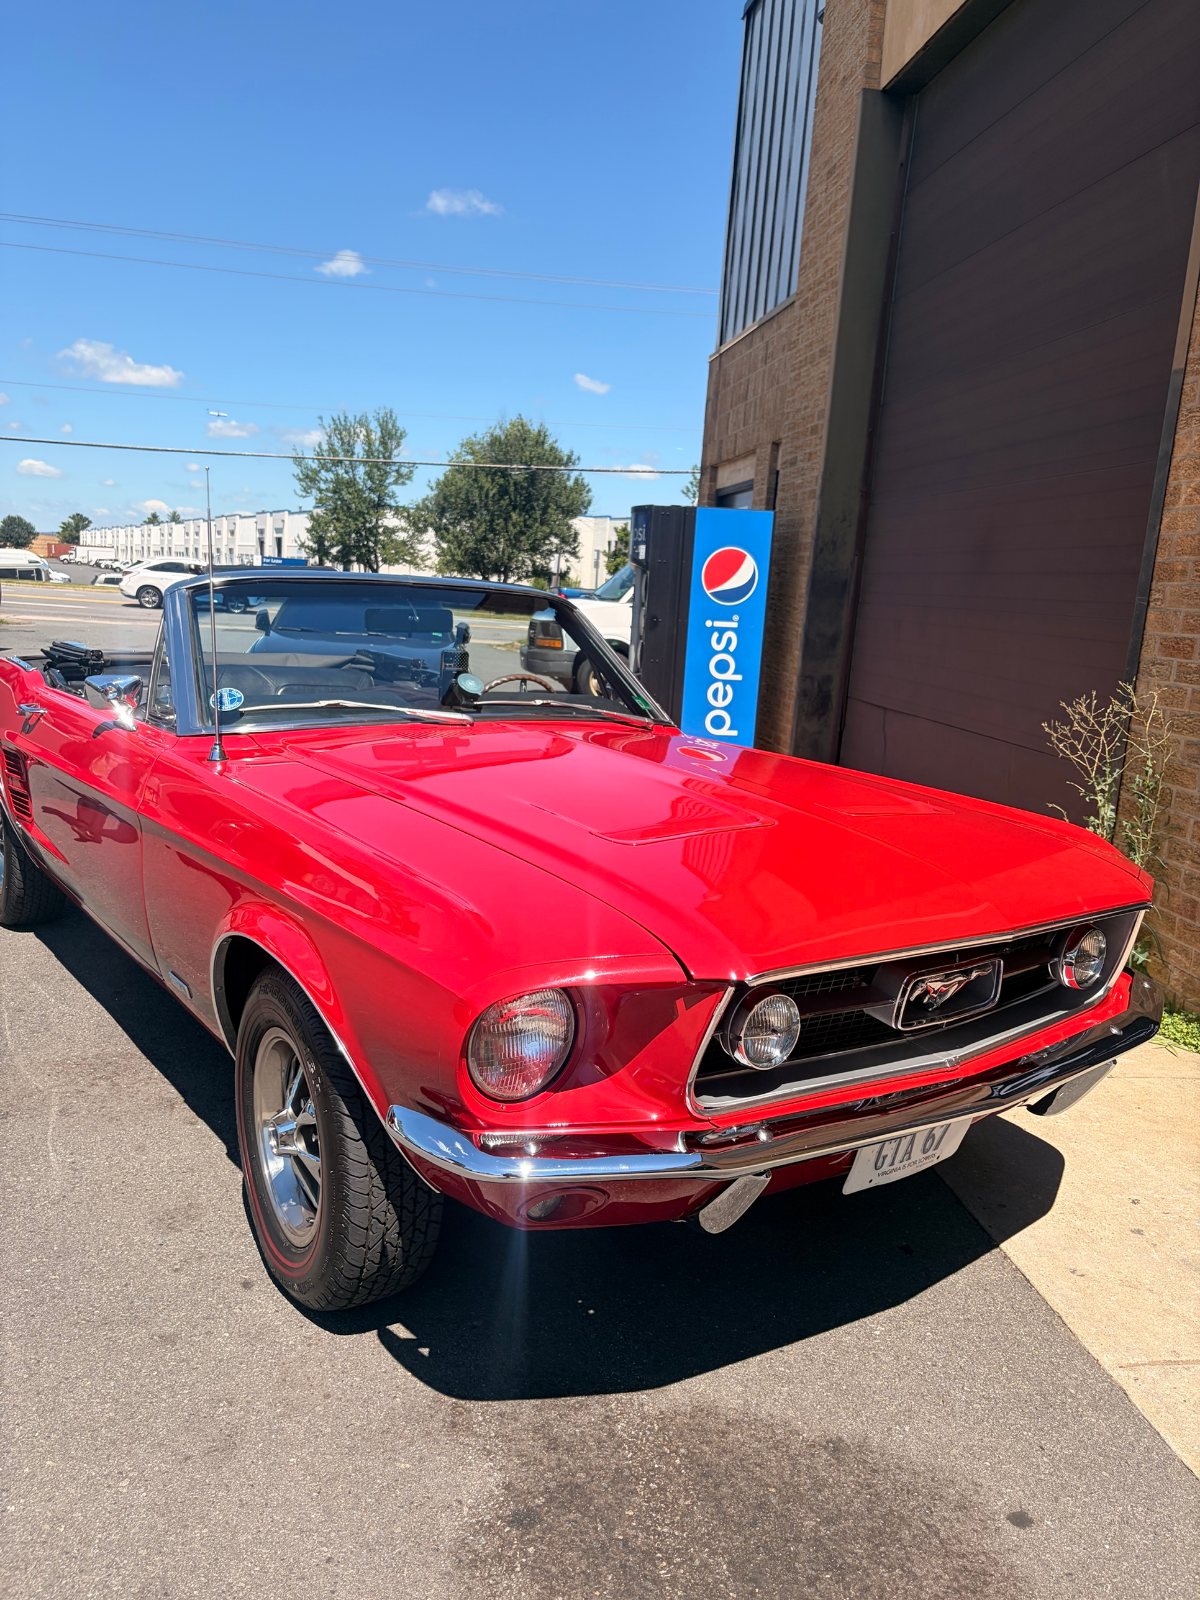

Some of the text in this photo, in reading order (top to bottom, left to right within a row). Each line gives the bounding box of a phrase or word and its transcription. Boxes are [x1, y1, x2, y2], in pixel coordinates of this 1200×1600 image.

[705, 619, 743, 737] pepsi
[874, 1123, 952, 1171] GTA 67
[877, 1166, 902, 1177] VIRGINIA
[907, 1160, 918, 1168] FOR
